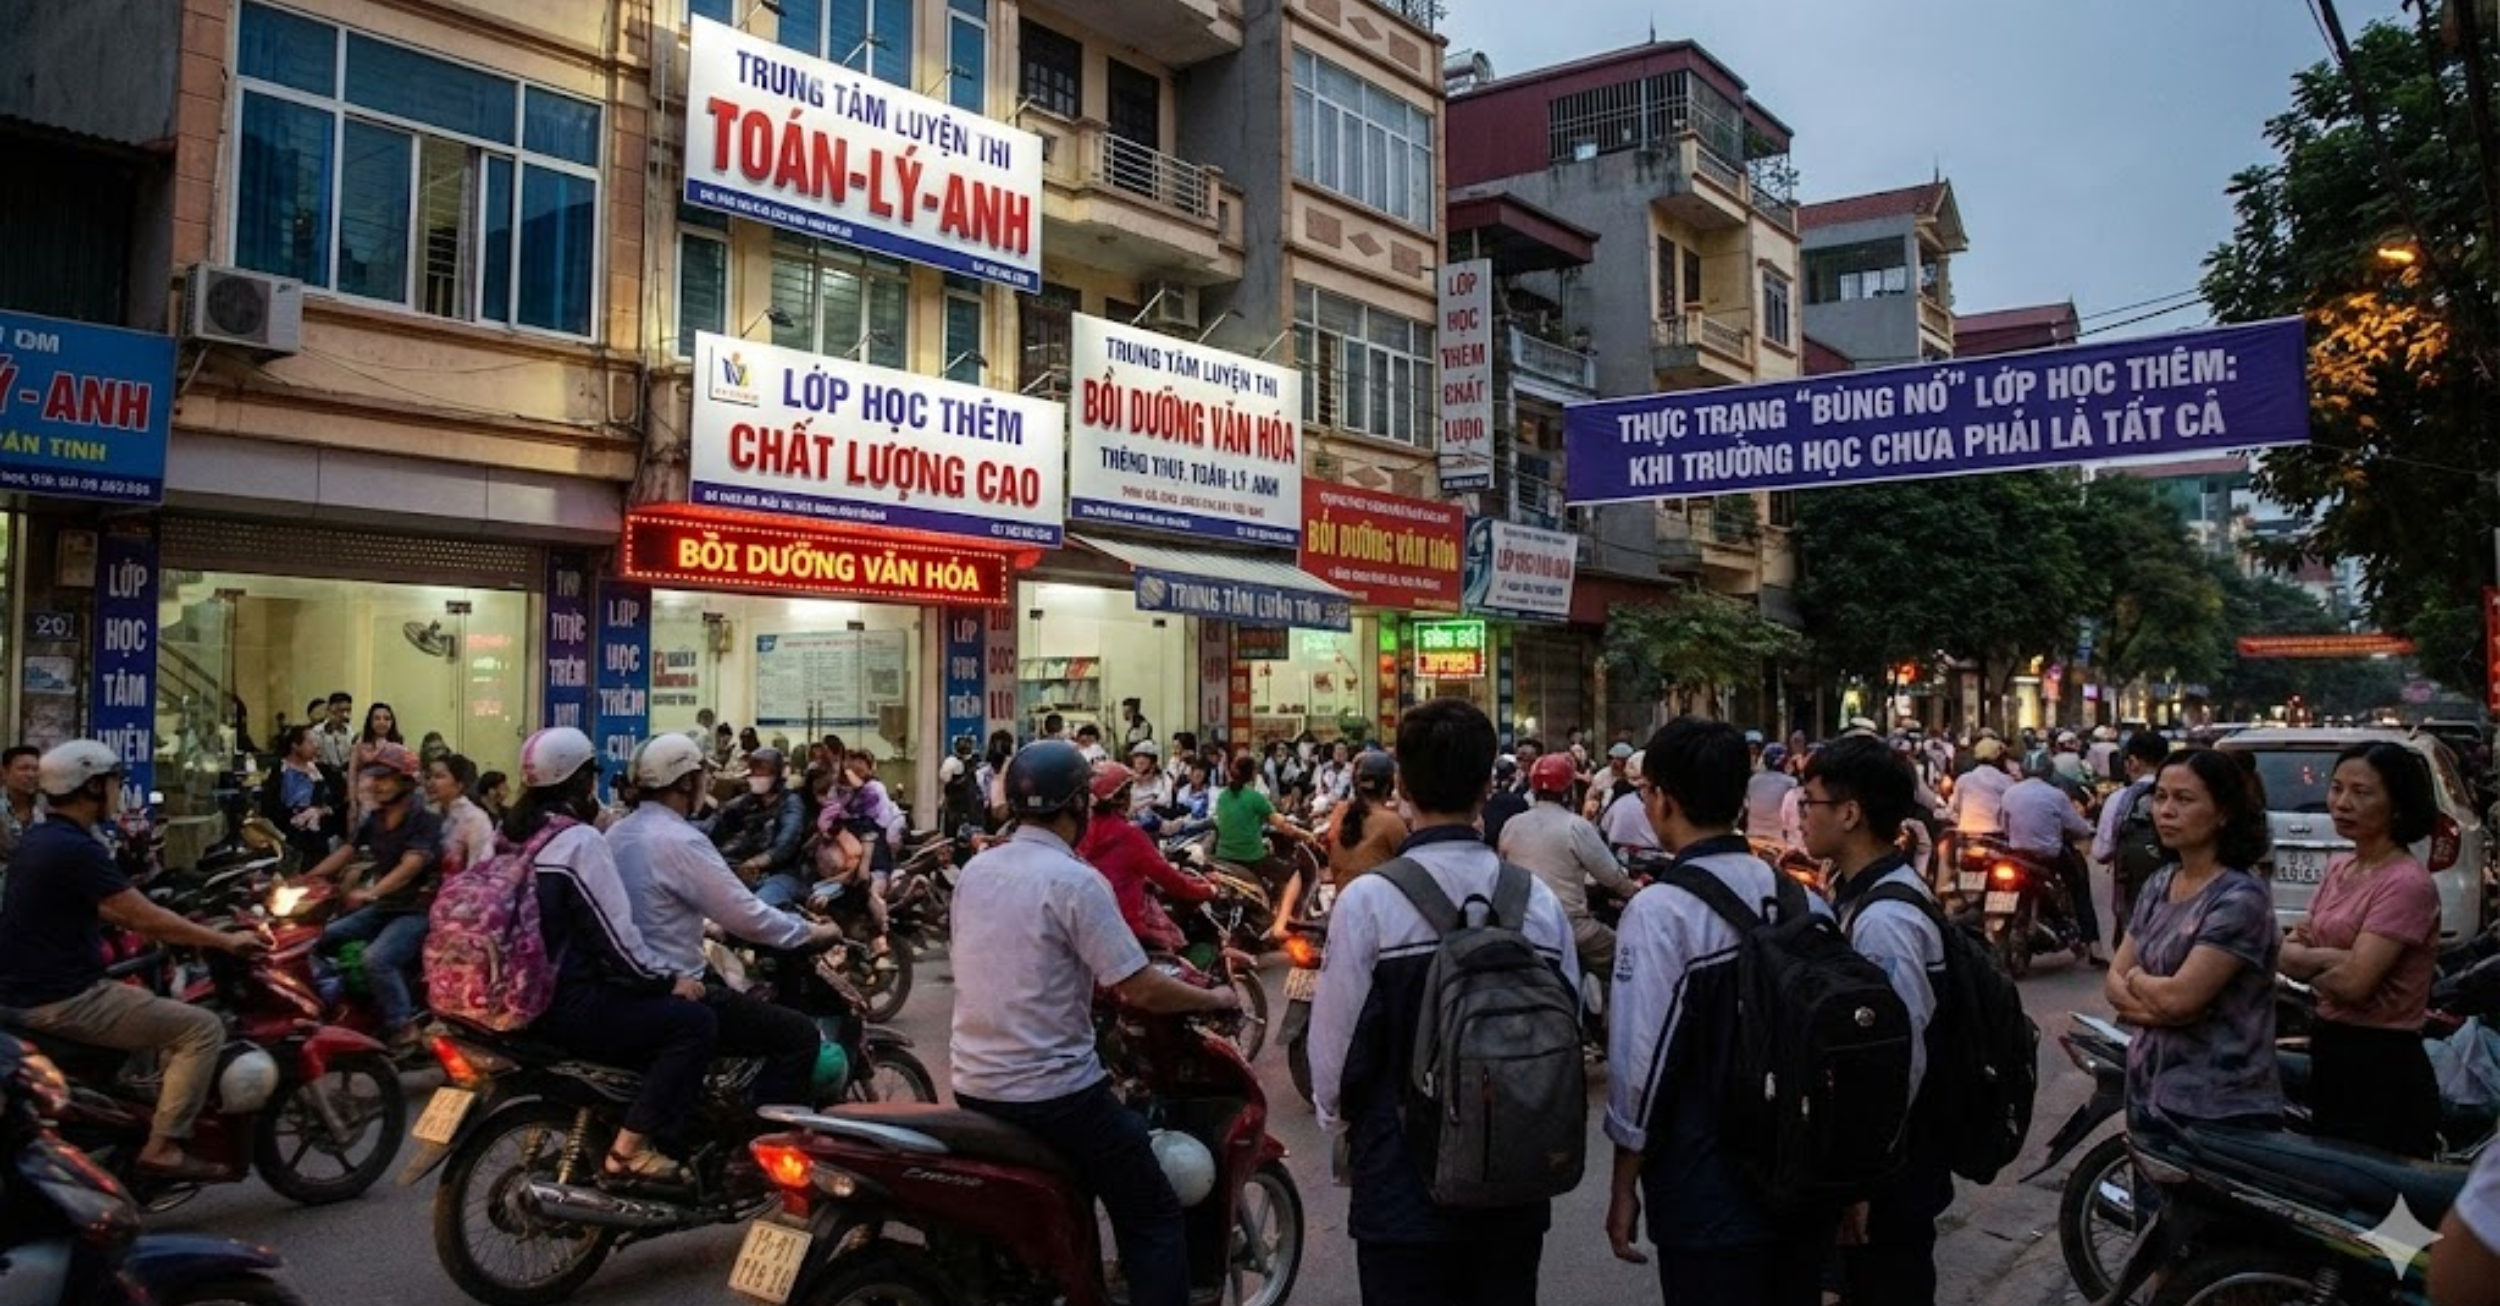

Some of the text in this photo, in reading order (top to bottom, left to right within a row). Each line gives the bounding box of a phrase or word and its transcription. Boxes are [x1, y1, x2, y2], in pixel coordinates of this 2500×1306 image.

[737, 50, 824, 108] TRUNG
[896, 108, 968, 157] LUYỆN
[977, 133, 1011, 171] THI
[706, 97, 1030, 257] TOÁN-LÝ-ANH
[783, 363, 1024, 446] LỚP HỌC THÊM
[1257, 410, 1296, 464] HÓA
[1618, 408, 1687, 446] THỰC
[1694, 398, 1787, 438] TRẠNG
[1976, 365, 2036, 408] LỚP
[2048, 361, 2116, 403] HỌC
[2126, 346, 2238, 391] THÊM:
[1629, 455, 1673, 486] KHI
[1682, 440, 1793, 482] TRƯỜNG
[1803, 437, 1861, 476] HỌC
[1871, 427, 1955, 467] CHƯA
[1965, 409, 2041, 457] PHẢI
[2051, 407, 2093, 449] LÀ
[2103, 395, 2165, 445] TẤT
[728, 417, 1041, 507] CHẤT LƯỢNG CAO
[747, 541, 856, 582] DƯỠNG
[861, 549, 919, 587] VĂN
[925, 556, 980, 592] HÓA
[105, 617, 147, 657] HỌC
